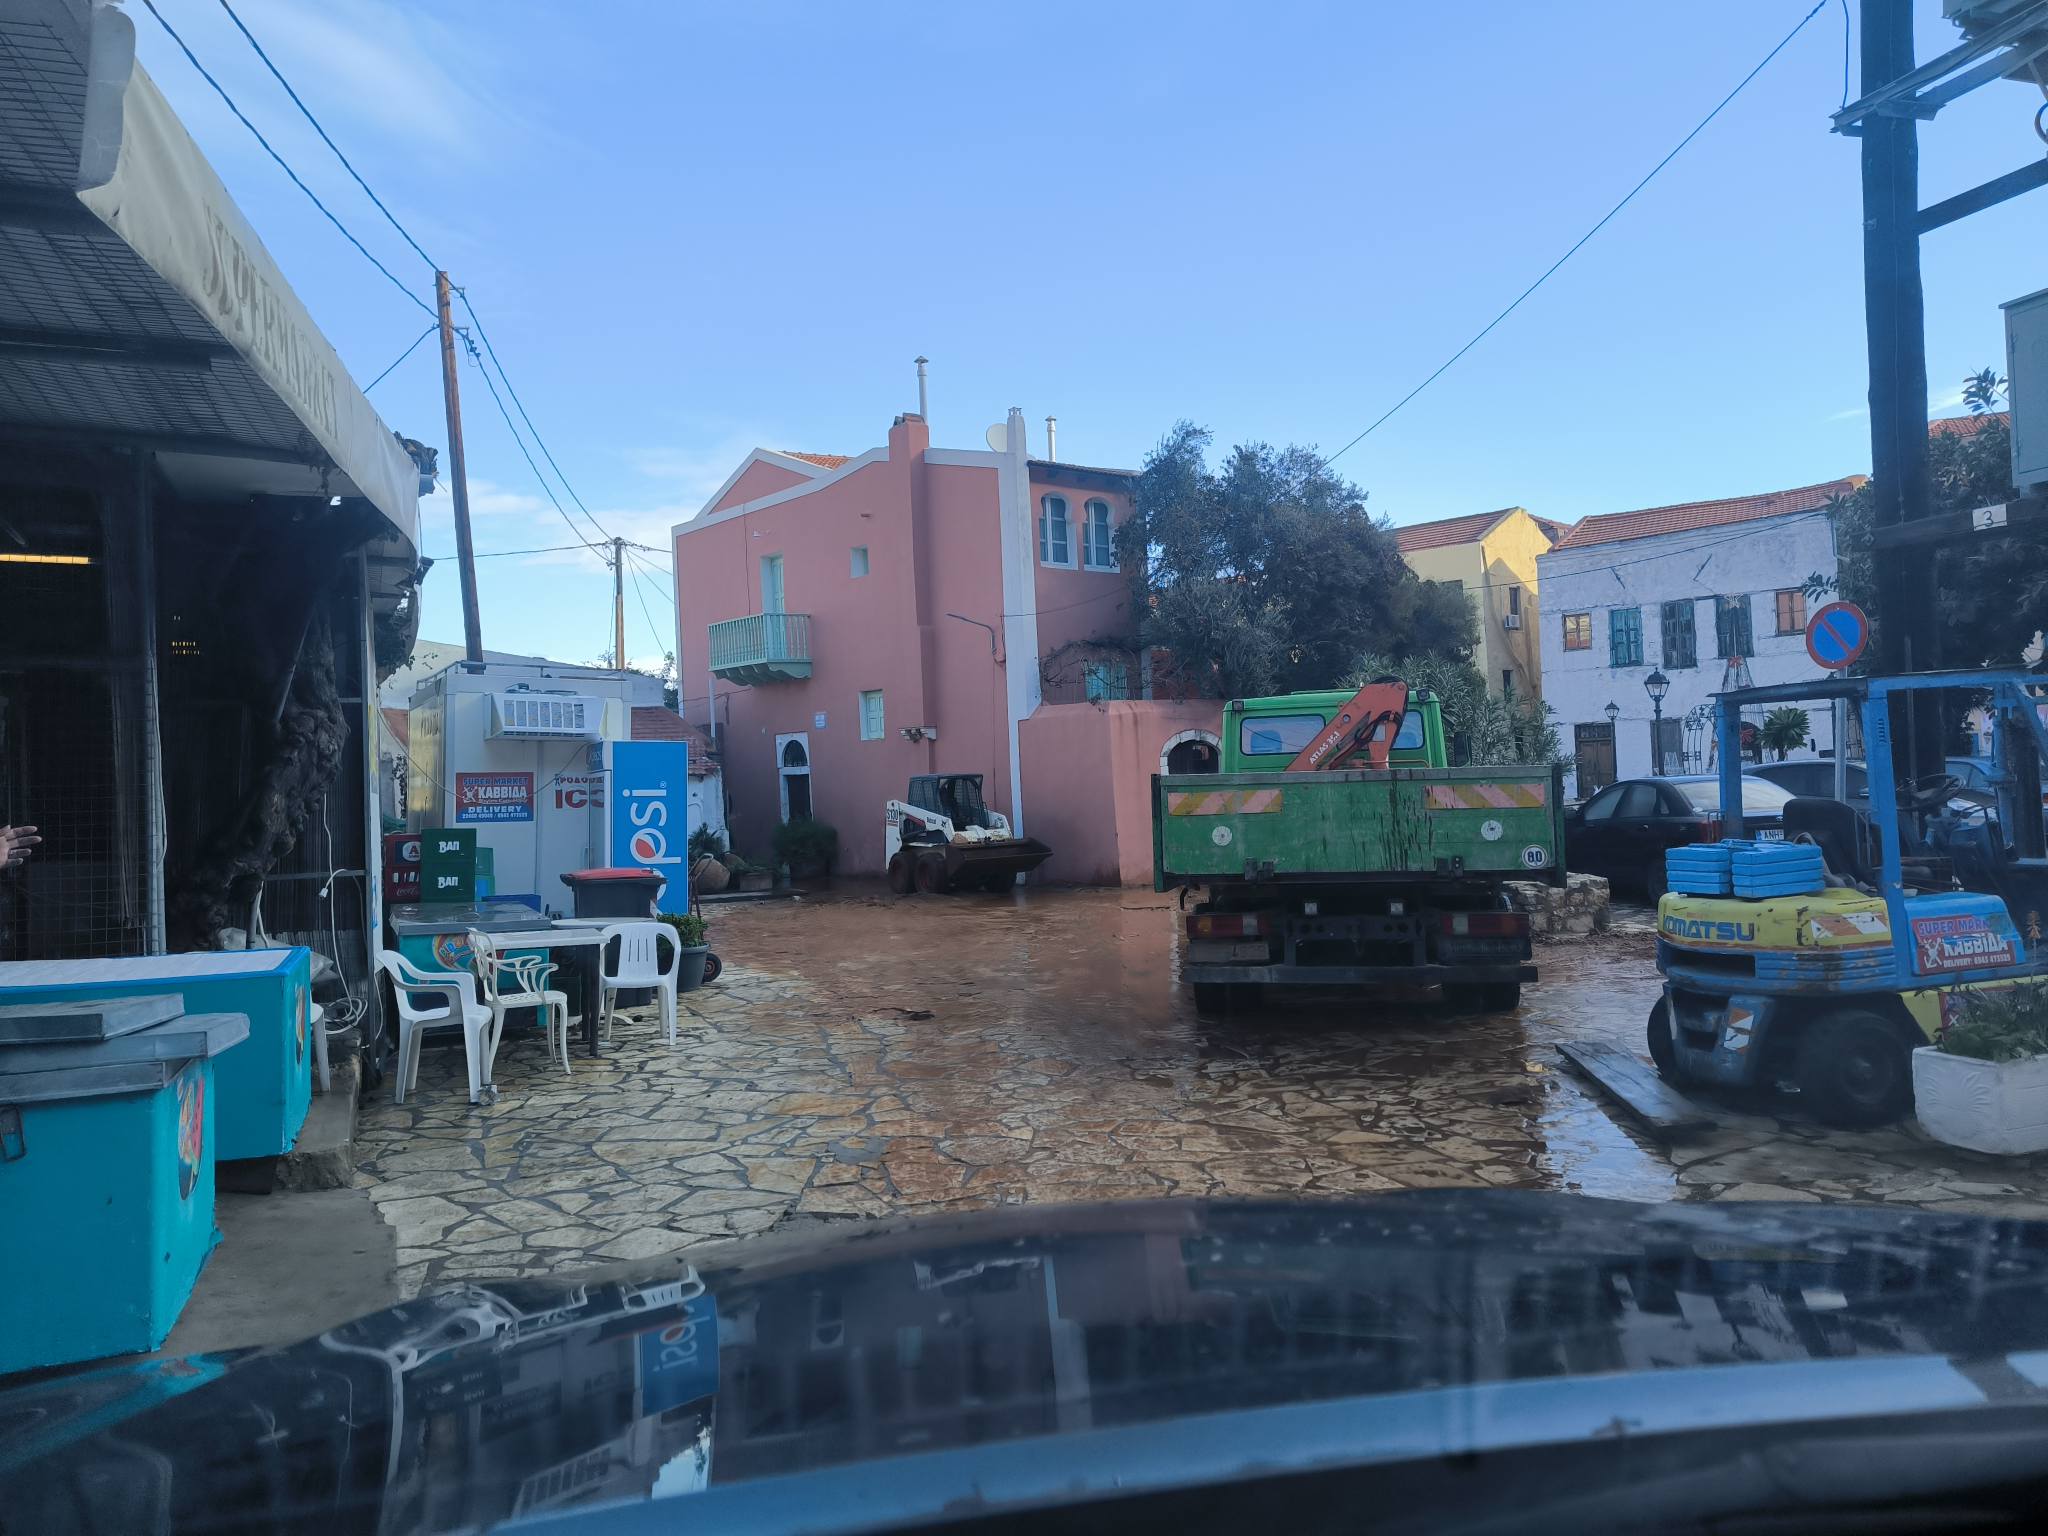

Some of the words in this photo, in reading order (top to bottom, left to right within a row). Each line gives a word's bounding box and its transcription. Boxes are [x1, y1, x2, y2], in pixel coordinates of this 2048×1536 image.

[1983, 510, 1994, 526] 3
[1310, 743, 1329, 764] ATLAS
[464, 777, 490, 785] SUPER
[494, 777, 528, 785] MARKET
[468, 805, 522, 813] DELIVERY
[622, 788, 682, 902] psi
[1527, 850, 1543, 863] 80
[1919, 921, 1953, 934] SUPER
